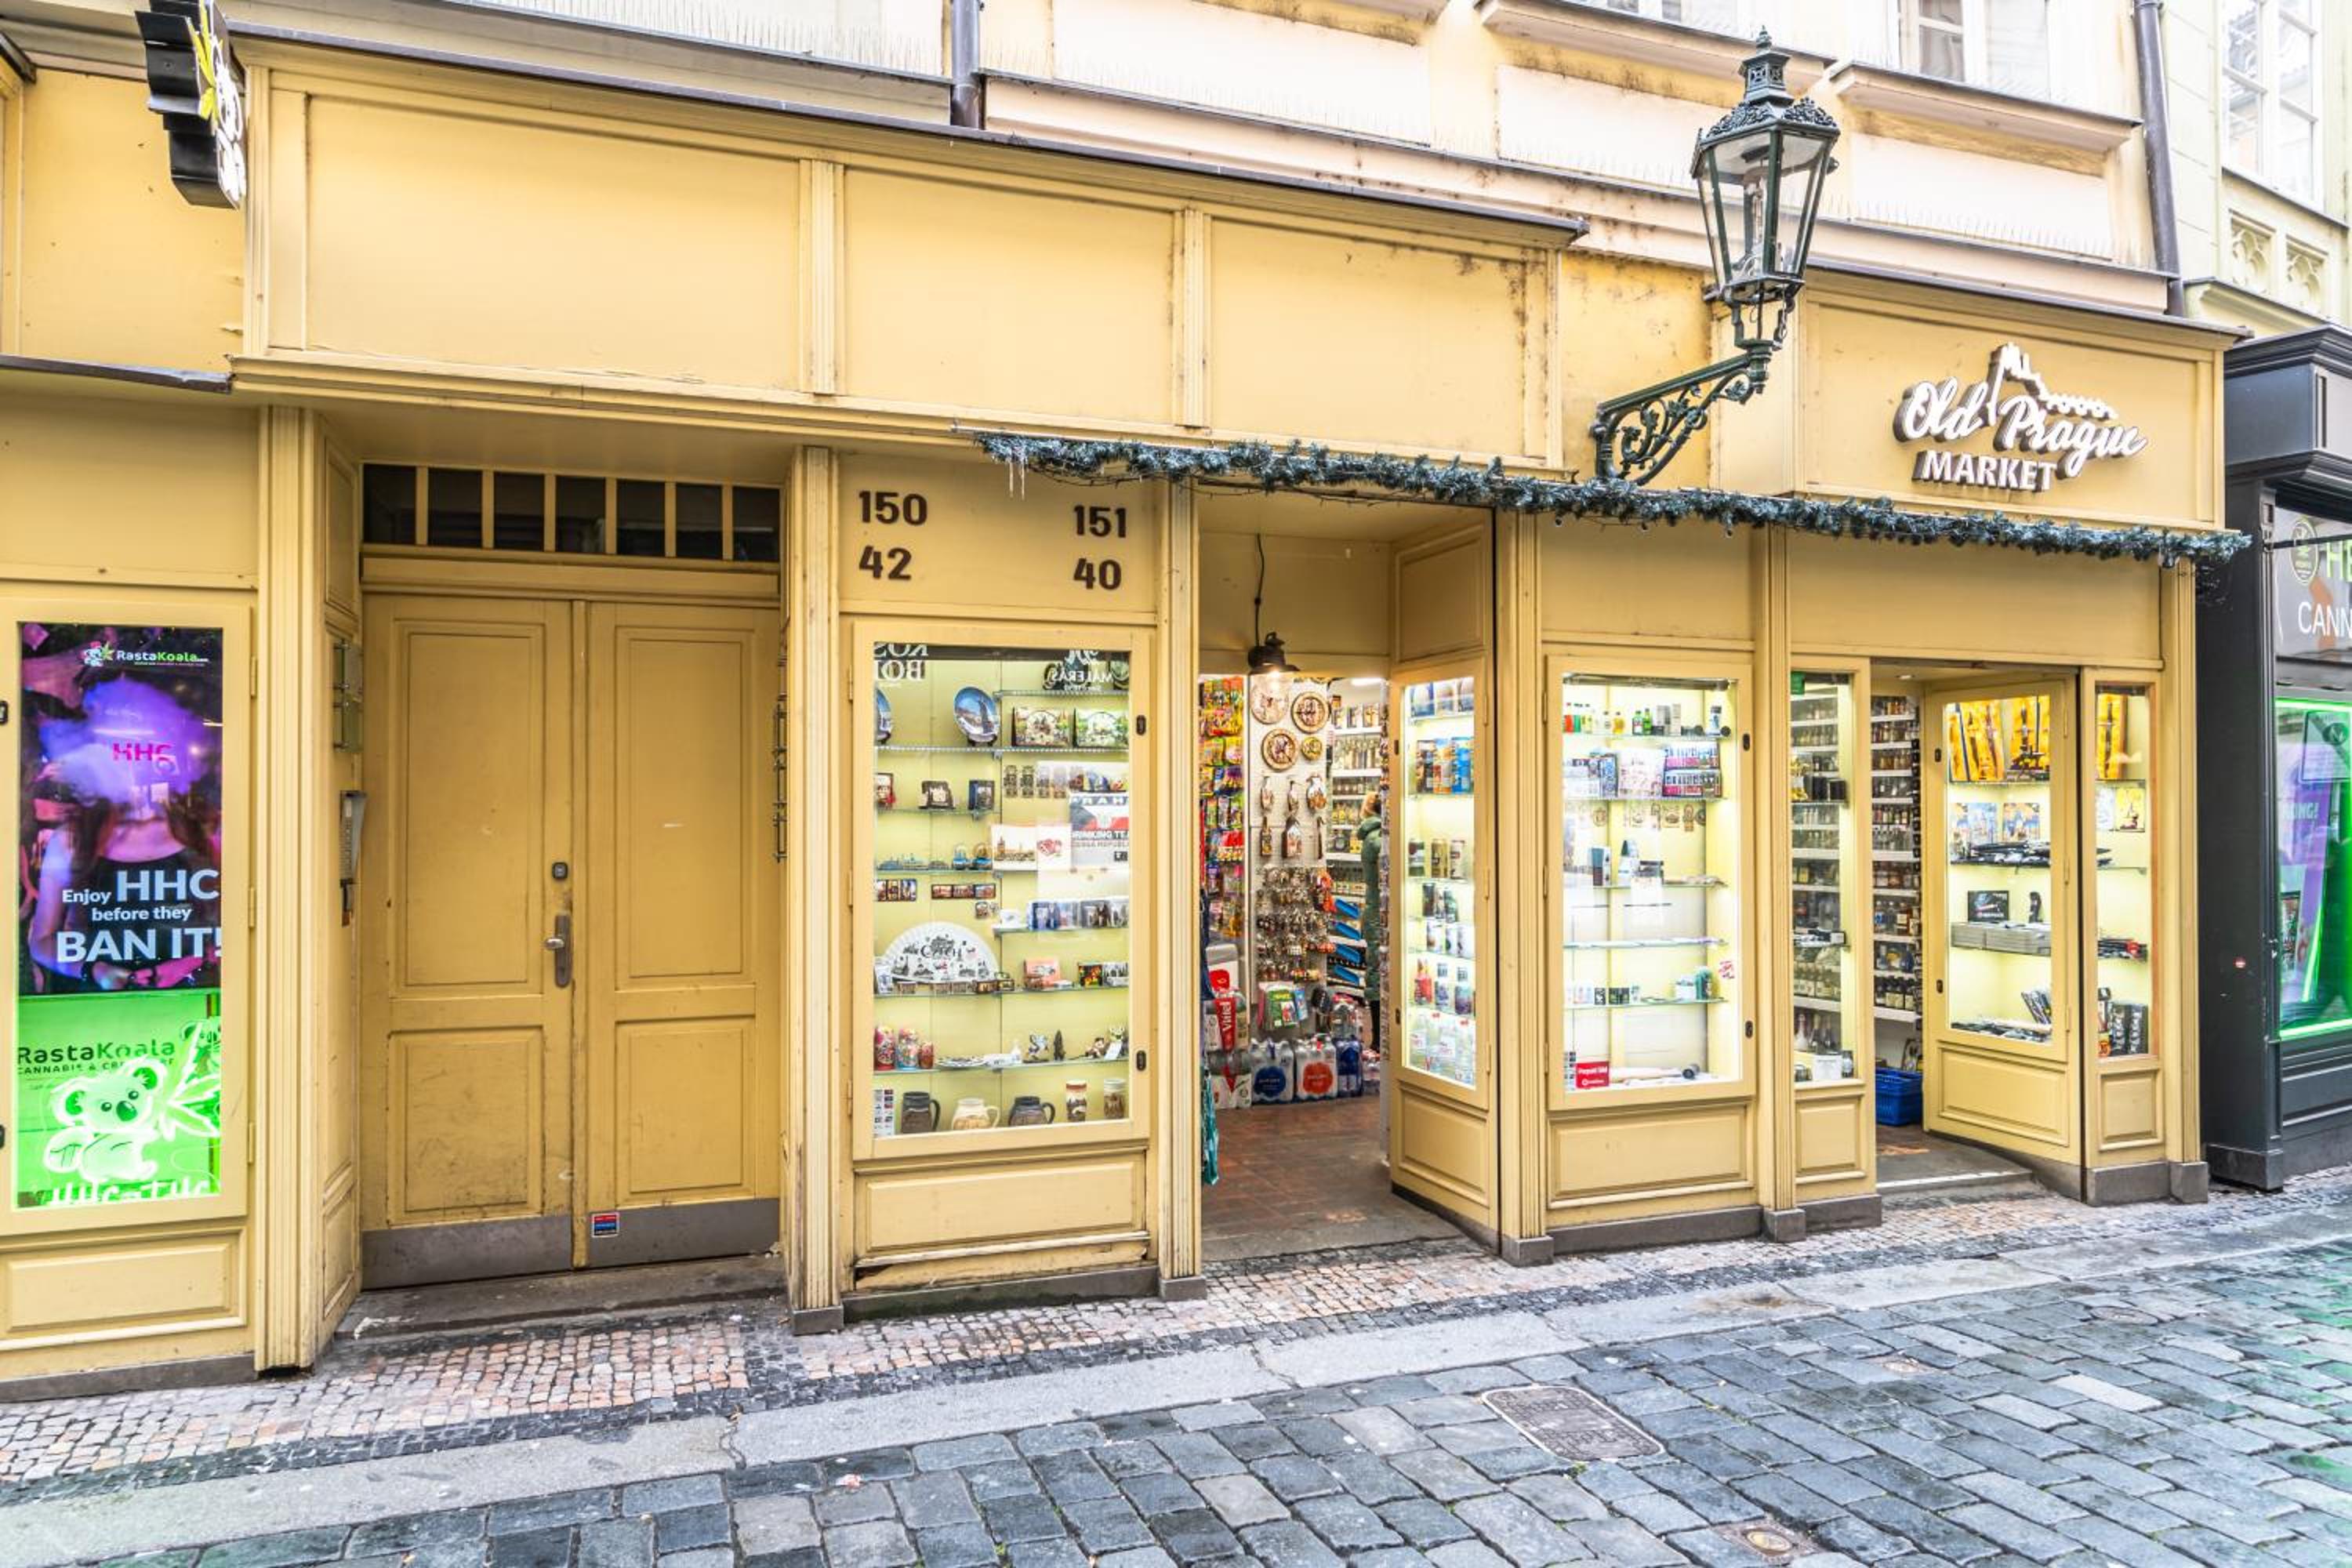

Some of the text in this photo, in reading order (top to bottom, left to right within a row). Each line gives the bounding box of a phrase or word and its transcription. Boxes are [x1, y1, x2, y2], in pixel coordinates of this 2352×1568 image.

[1900, 376, 2148, 477] Old Prague
[1918, 448, 2058, 492] MARKET
[858, 491, 927, 525] 150
[1073, 505, 1127, 538] 151
[858, 546, 912, 581] 42
[1073, 557, 1122, 590] 40
[62, 870, 220, 906] Enjoy HHC
[92, 906, 192, 921] before they
[56, 929, 156, 964] BAN
[17, 1040, 176, 1065] RastaKoala
